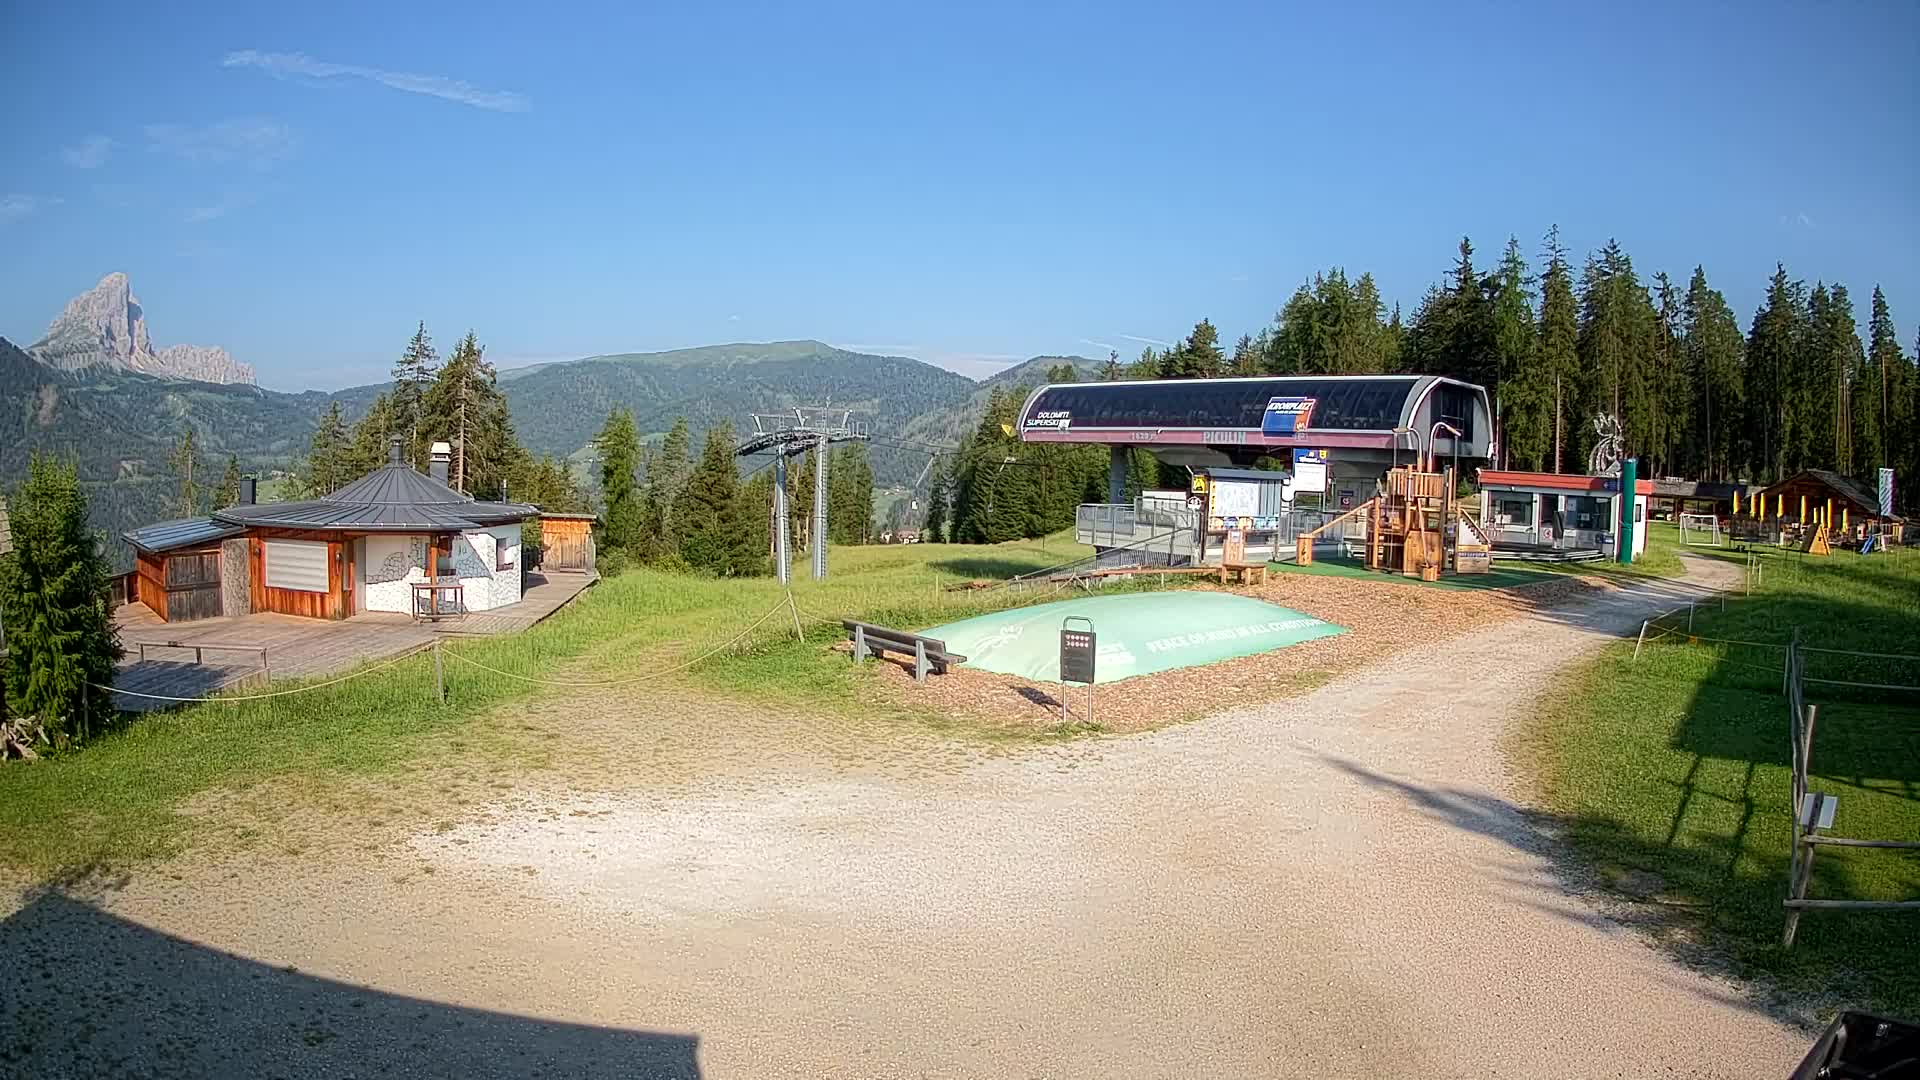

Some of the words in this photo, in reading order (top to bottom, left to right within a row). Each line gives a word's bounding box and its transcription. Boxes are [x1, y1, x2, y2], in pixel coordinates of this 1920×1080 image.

[1038, 411, 1069, 419] DOLOMITI
[1203, 431, 1246, 443] PICULIN
[1146, 636, 1190, 652] PEACE
[1189, 632, 1205, 645] OF
[1206, 629, 1237, 642] MIND
[1250, 623, 1271, 634] ALL
